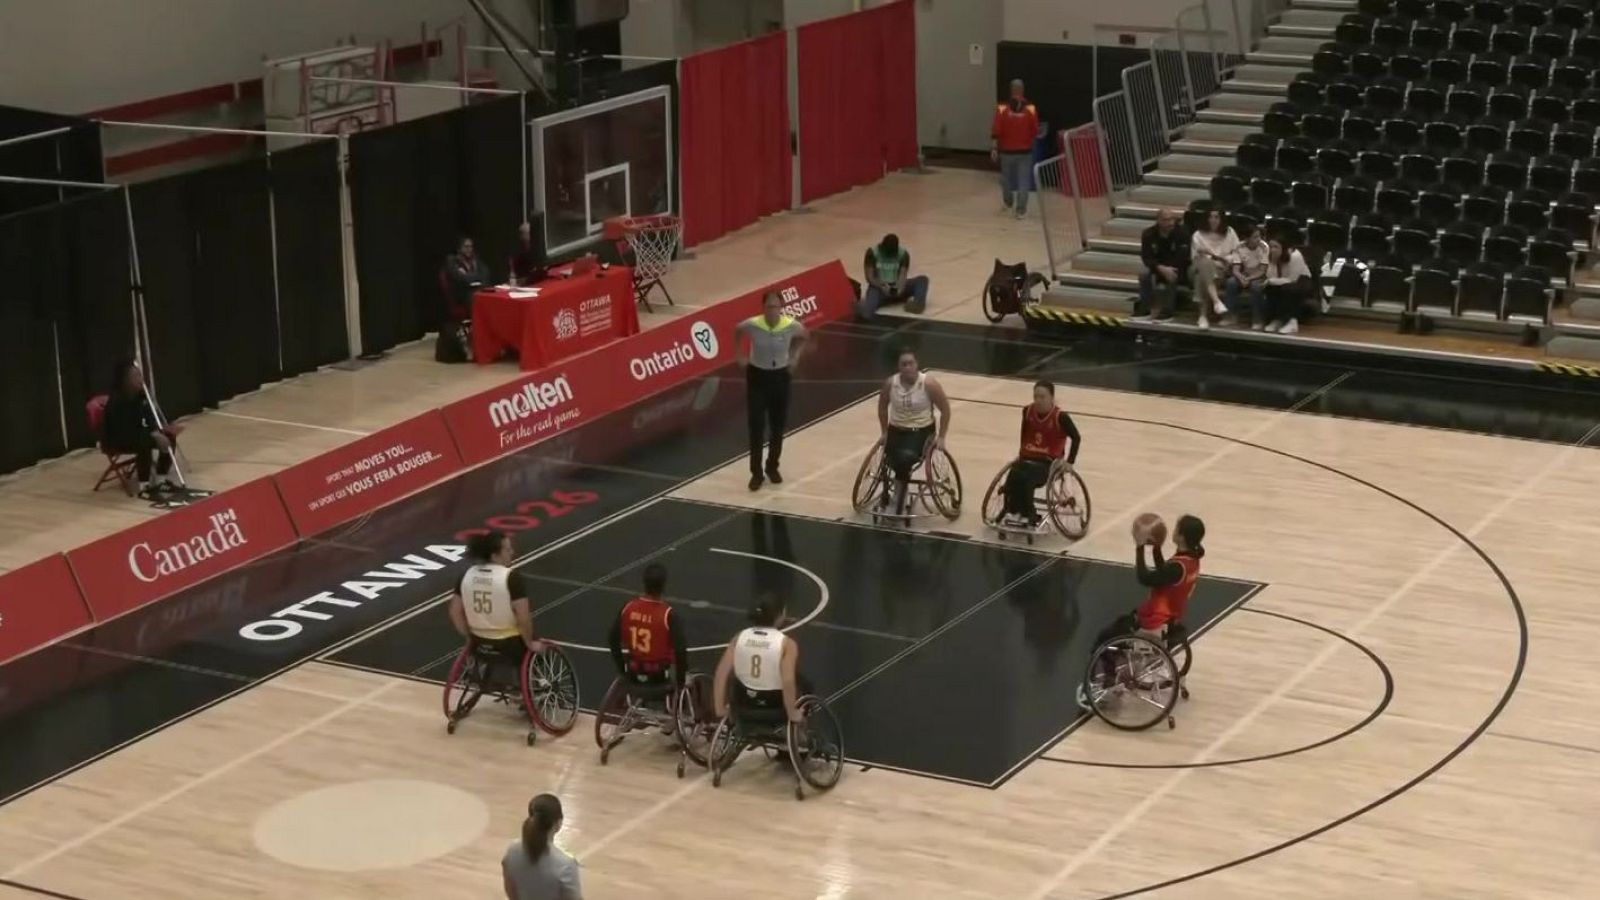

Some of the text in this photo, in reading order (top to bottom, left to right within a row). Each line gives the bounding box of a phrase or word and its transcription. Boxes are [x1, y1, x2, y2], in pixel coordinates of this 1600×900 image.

[579, 293, 612, 312] OTTAWA
[780, 296, 818, 318] ISSOT
[630, 341, 694, 381] Ontario
[488, 376, 574, 428] molten
[499, 407, 581, 448] For the real game
[354, 452, 386, 473] MOVES
[345, 476, 374, 496] VOUS
[373, 468, 398, 485] FERA
[128, 508, 248, 582] Canada
[239, 544, 468, 641] OTTAWA
[473, 590, 493, 615] 55
[629, 626, 652, 654] 13
[751, 653, 762, 679] 8
